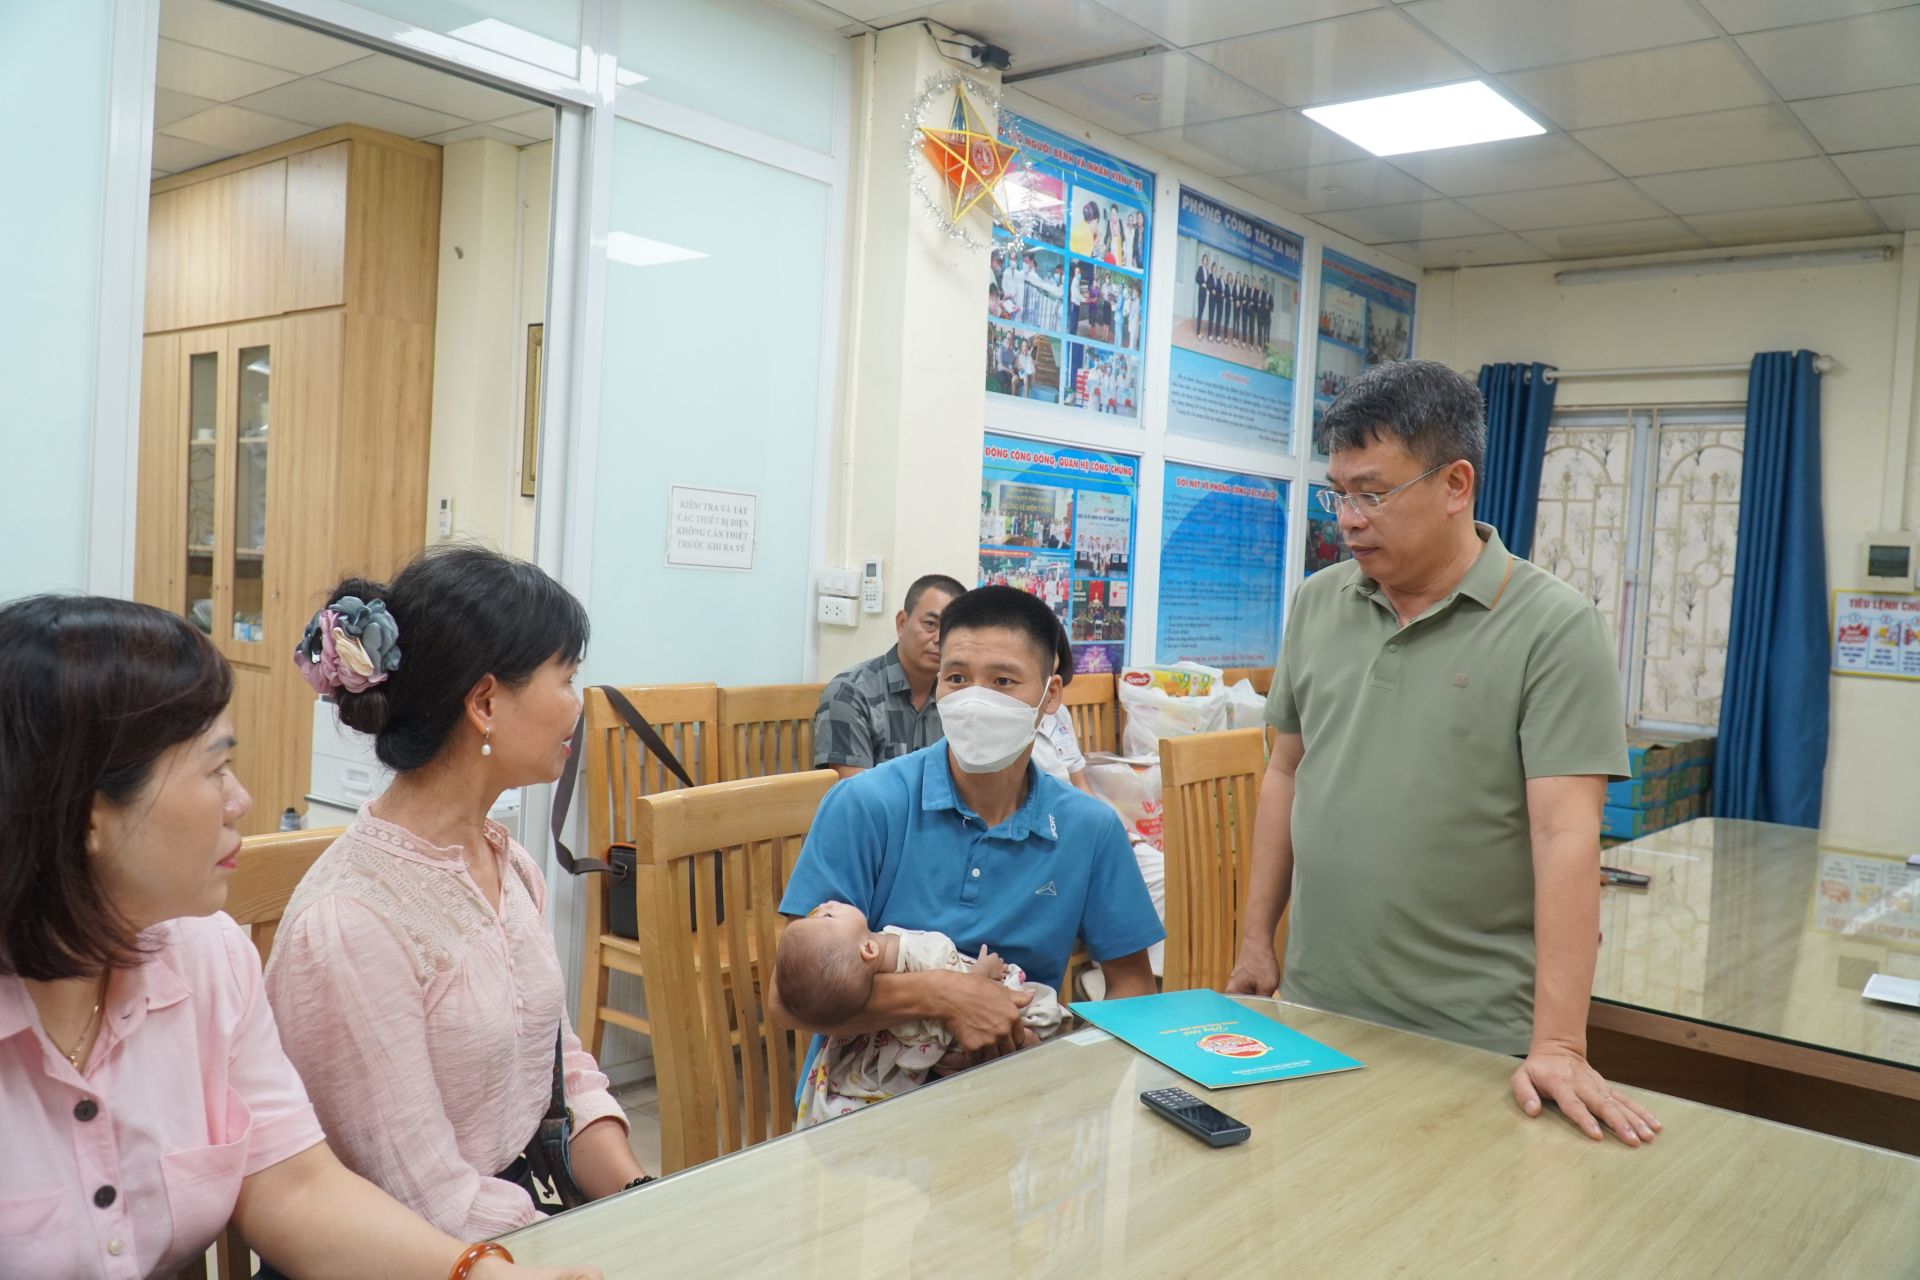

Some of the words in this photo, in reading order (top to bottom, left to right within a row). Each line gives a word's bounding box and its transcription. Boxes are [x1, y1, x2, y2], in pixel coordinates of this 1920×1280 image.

[1224, 212, 1253, 239] CÔNG
[984, 445, 1008, 459] ĐỘNG
[1059, 456, 1079, 469] QUAN
[1079, 458, 1090, 473] HỆ
[1090, 459, 1109, 473] CÔNG
[1110, 463, 1133, 477] CHÚNG
[703, 502, 719, 512] TRA
[720, 503, 731, 513] VÀ
[677, 512, 694, 523] CÁC
[676, 525, 706, 537] KHÔNG
[706, 541, 722, 551] KHI
[723, 543, 734, 552] RA
